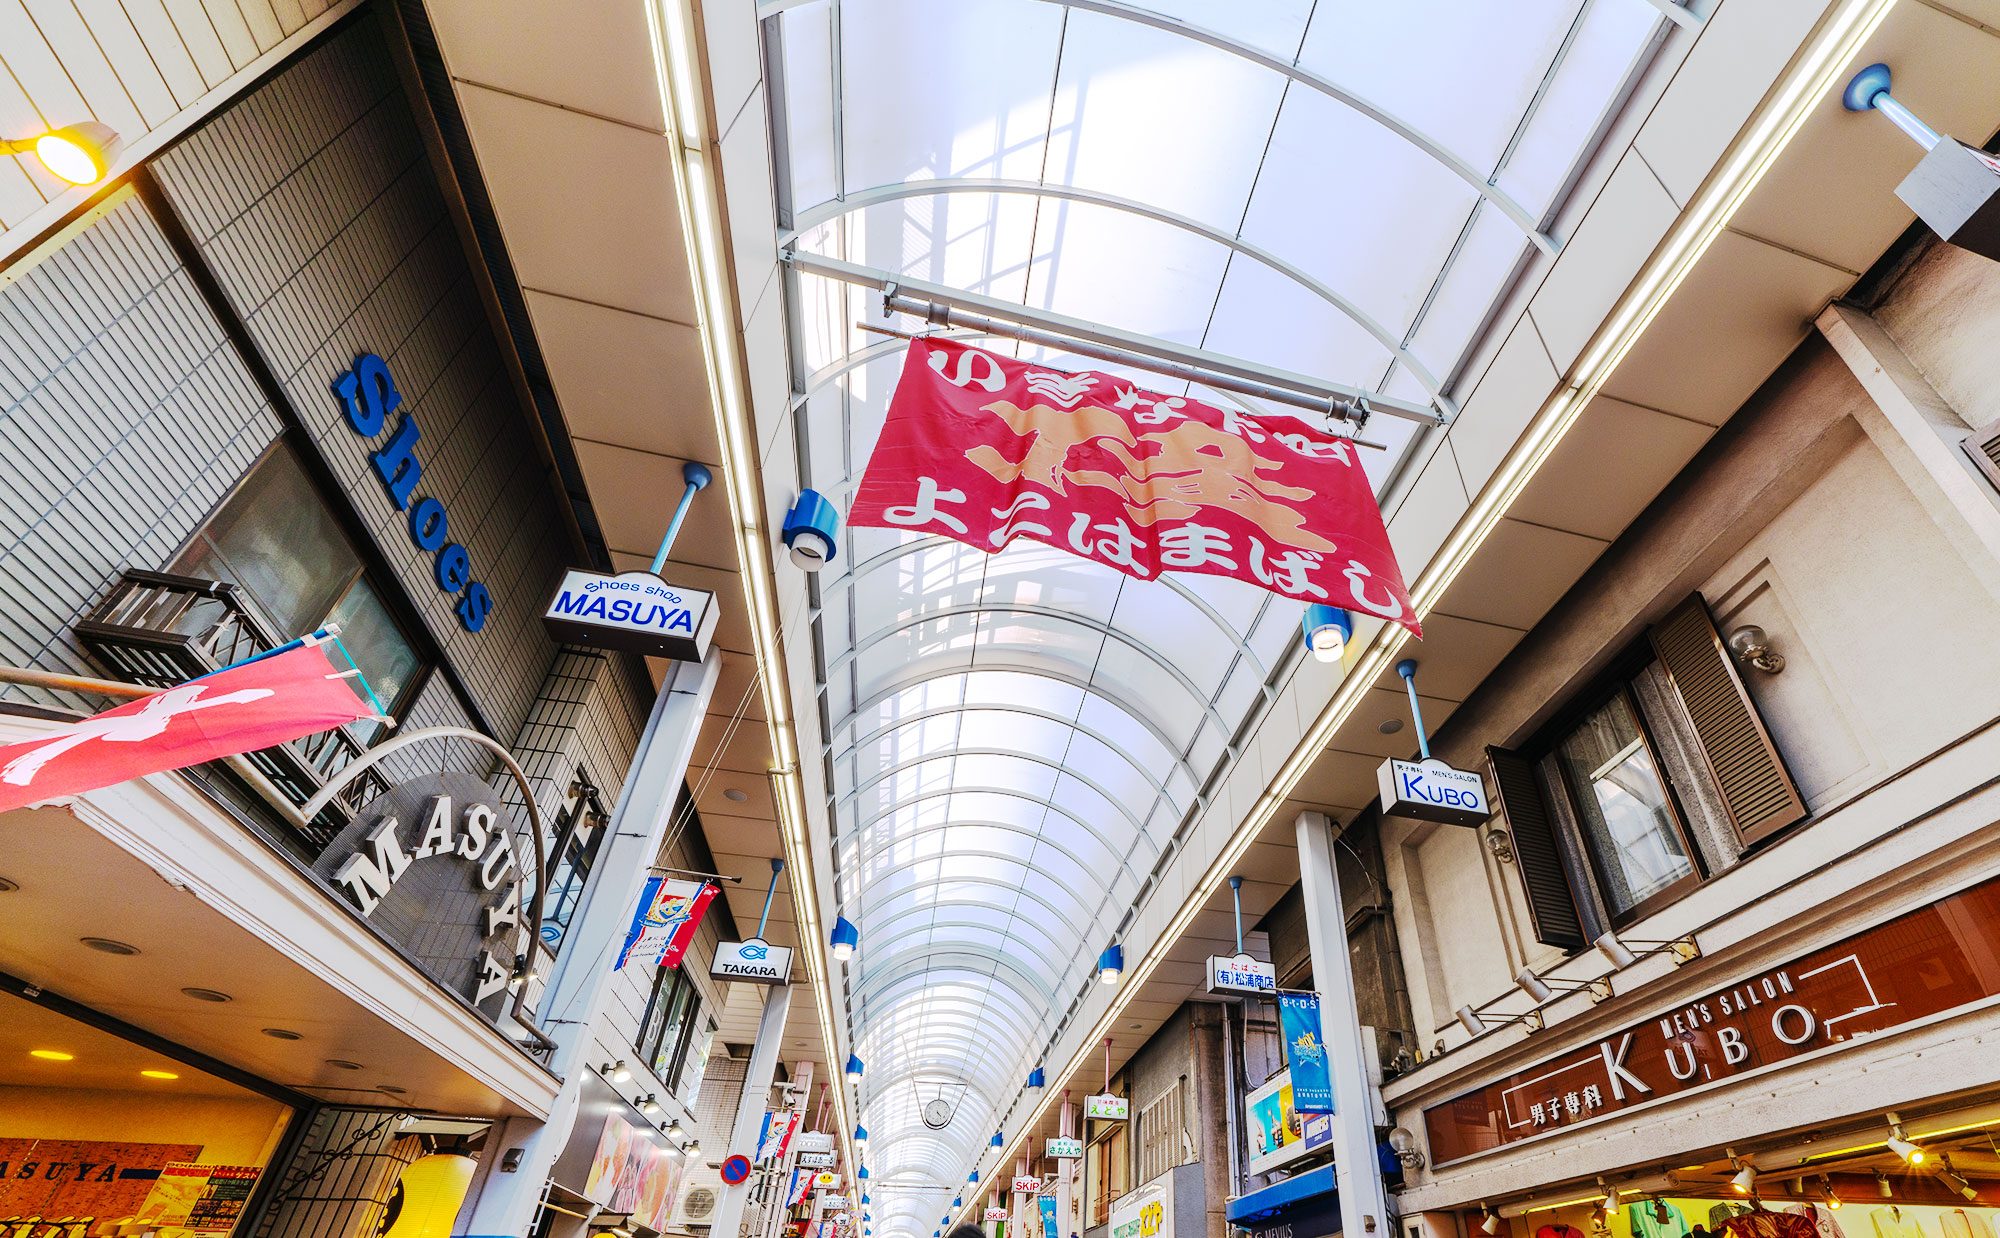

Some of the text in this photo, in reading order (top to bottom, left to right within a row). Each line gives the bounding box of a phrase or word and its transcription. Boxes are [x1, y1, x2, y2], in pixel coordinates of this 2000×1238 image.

[331, 352, 493, 633] Shoes
[882, 475, 1403, 619] よこはまばし
[554, 590, 693, 633] MASUYA
[645, 585, 682, 605] shop
[1403, 773, 1479, 808] KUBO
[1454, 771, 1478, 783] SALON
[338, 795, 520, 1006] MASUYA
[722, 963, 777, 976] TAKARA
[1660, 971, 1794, 1040] MEN'S SALON
[1600, 1004, 1817, 1101] KUBO
[1090, 1104, 1126, 1116] えどや
[1529, 1084, 1603, 1127] 男子専科
[1049, 1145, 1083, 1155] さかえや
